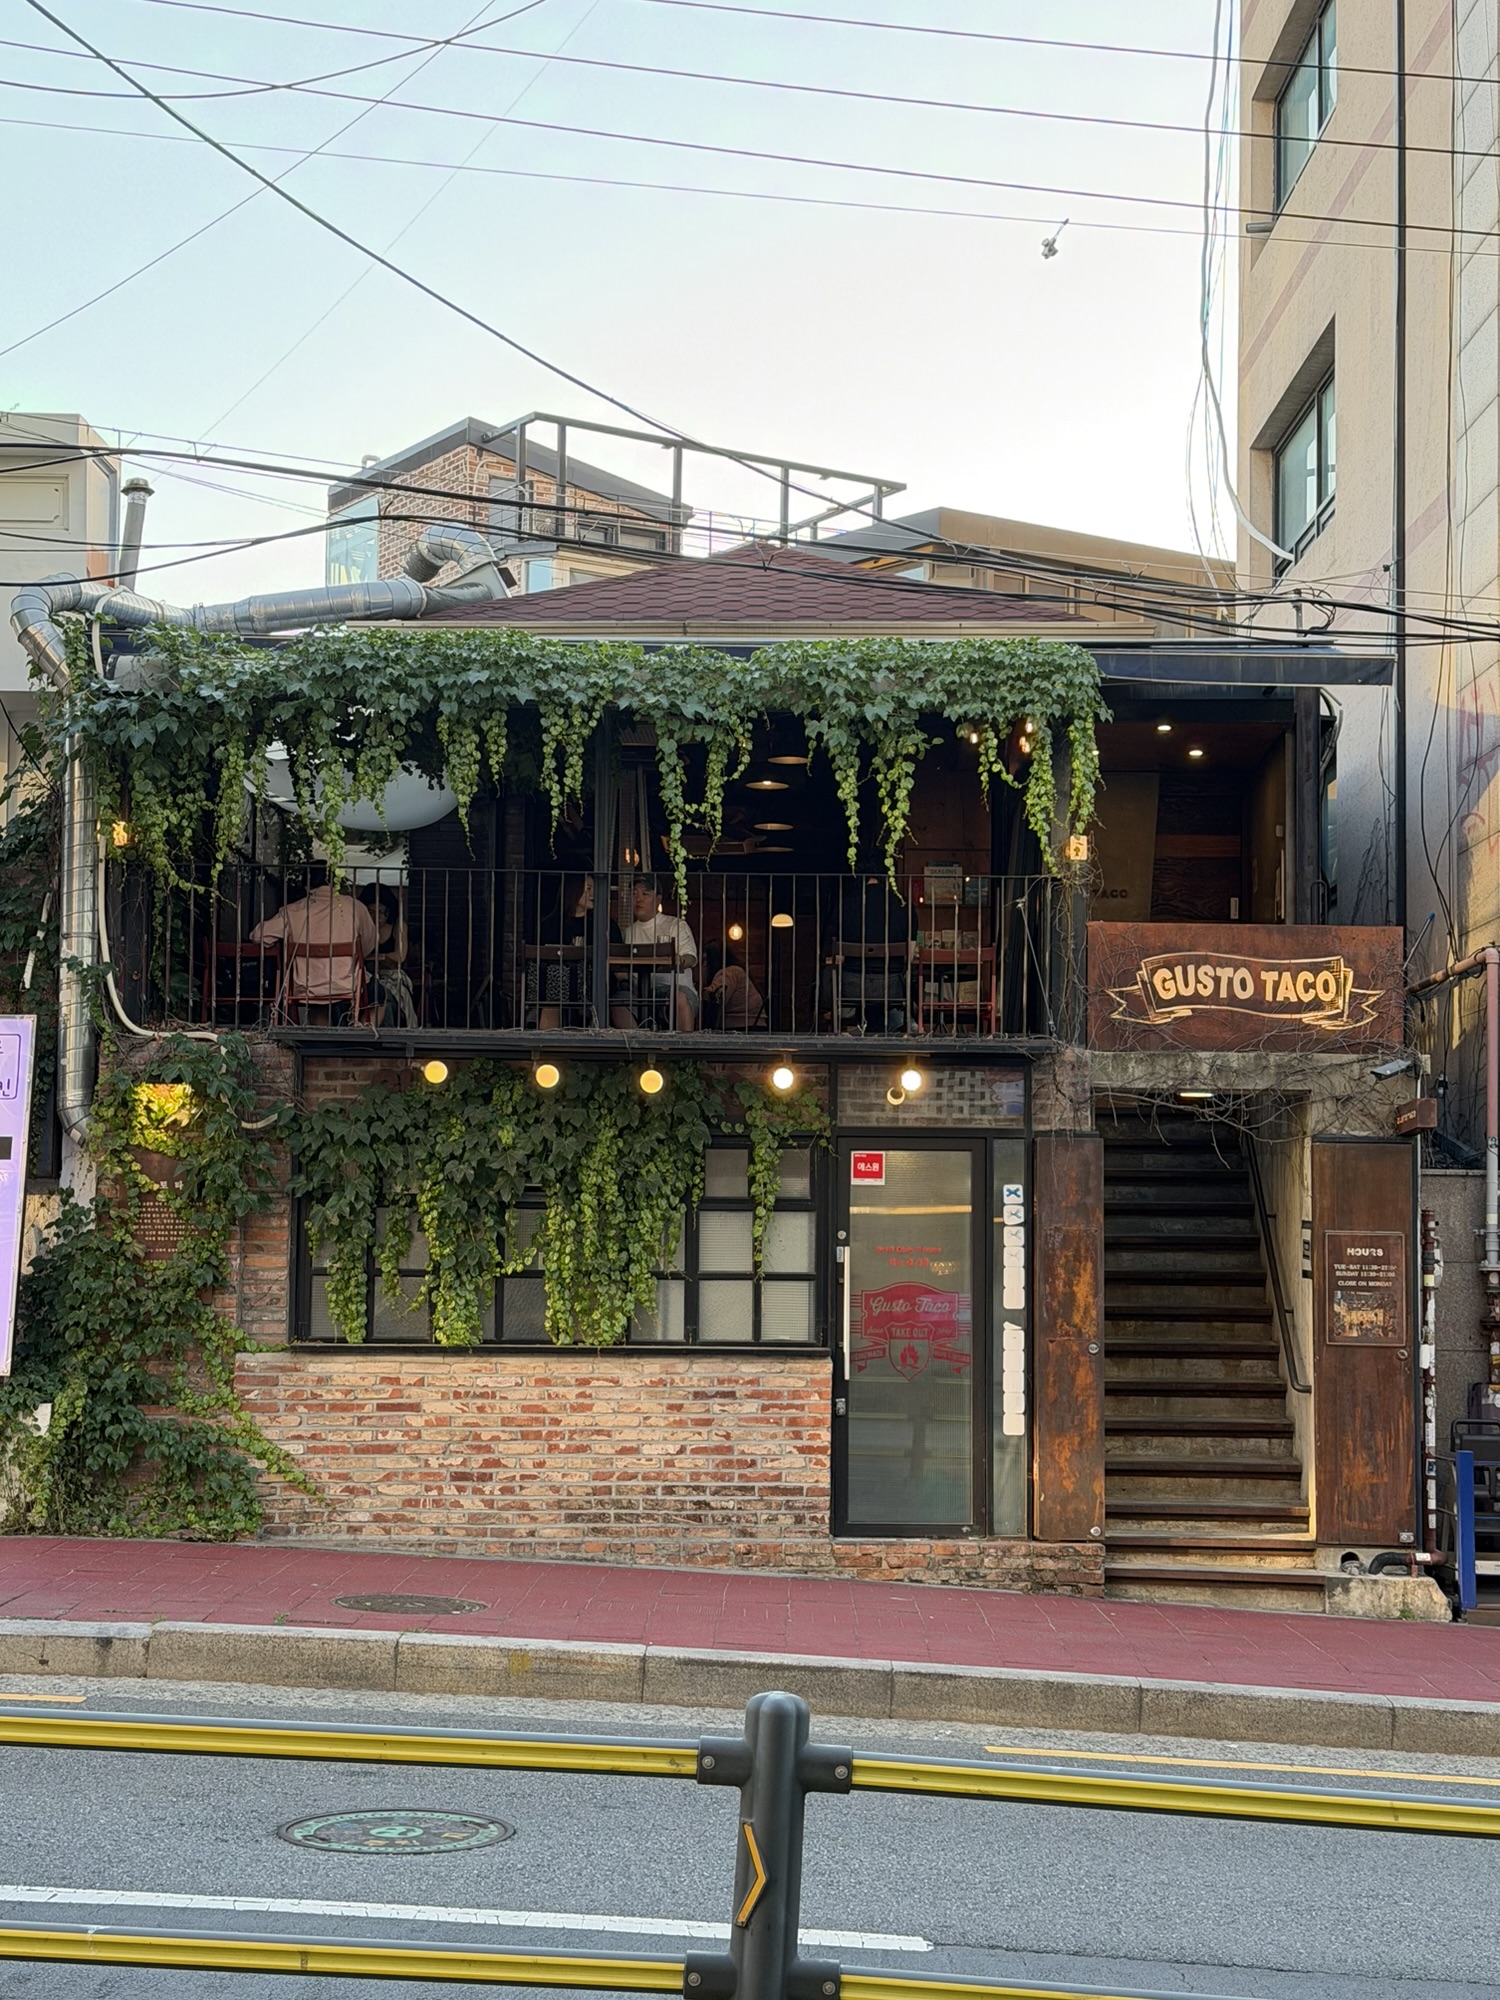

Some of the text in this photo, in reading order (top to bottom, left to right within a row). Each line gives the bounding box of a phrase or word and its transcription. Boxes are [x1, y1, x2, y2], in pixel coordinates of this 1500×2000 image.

[1153, 964, 1336, 1003] GUSTO TACO
[857, 1162, 880, 1172] 에스원
[1347, 1248, 1384, 1256] HOURS
[869, 1296, 951, 1317] Gusto Taco
[891, 1327, 911, 1338] TAKE
[912, 1327, 929, 1338] OUT
